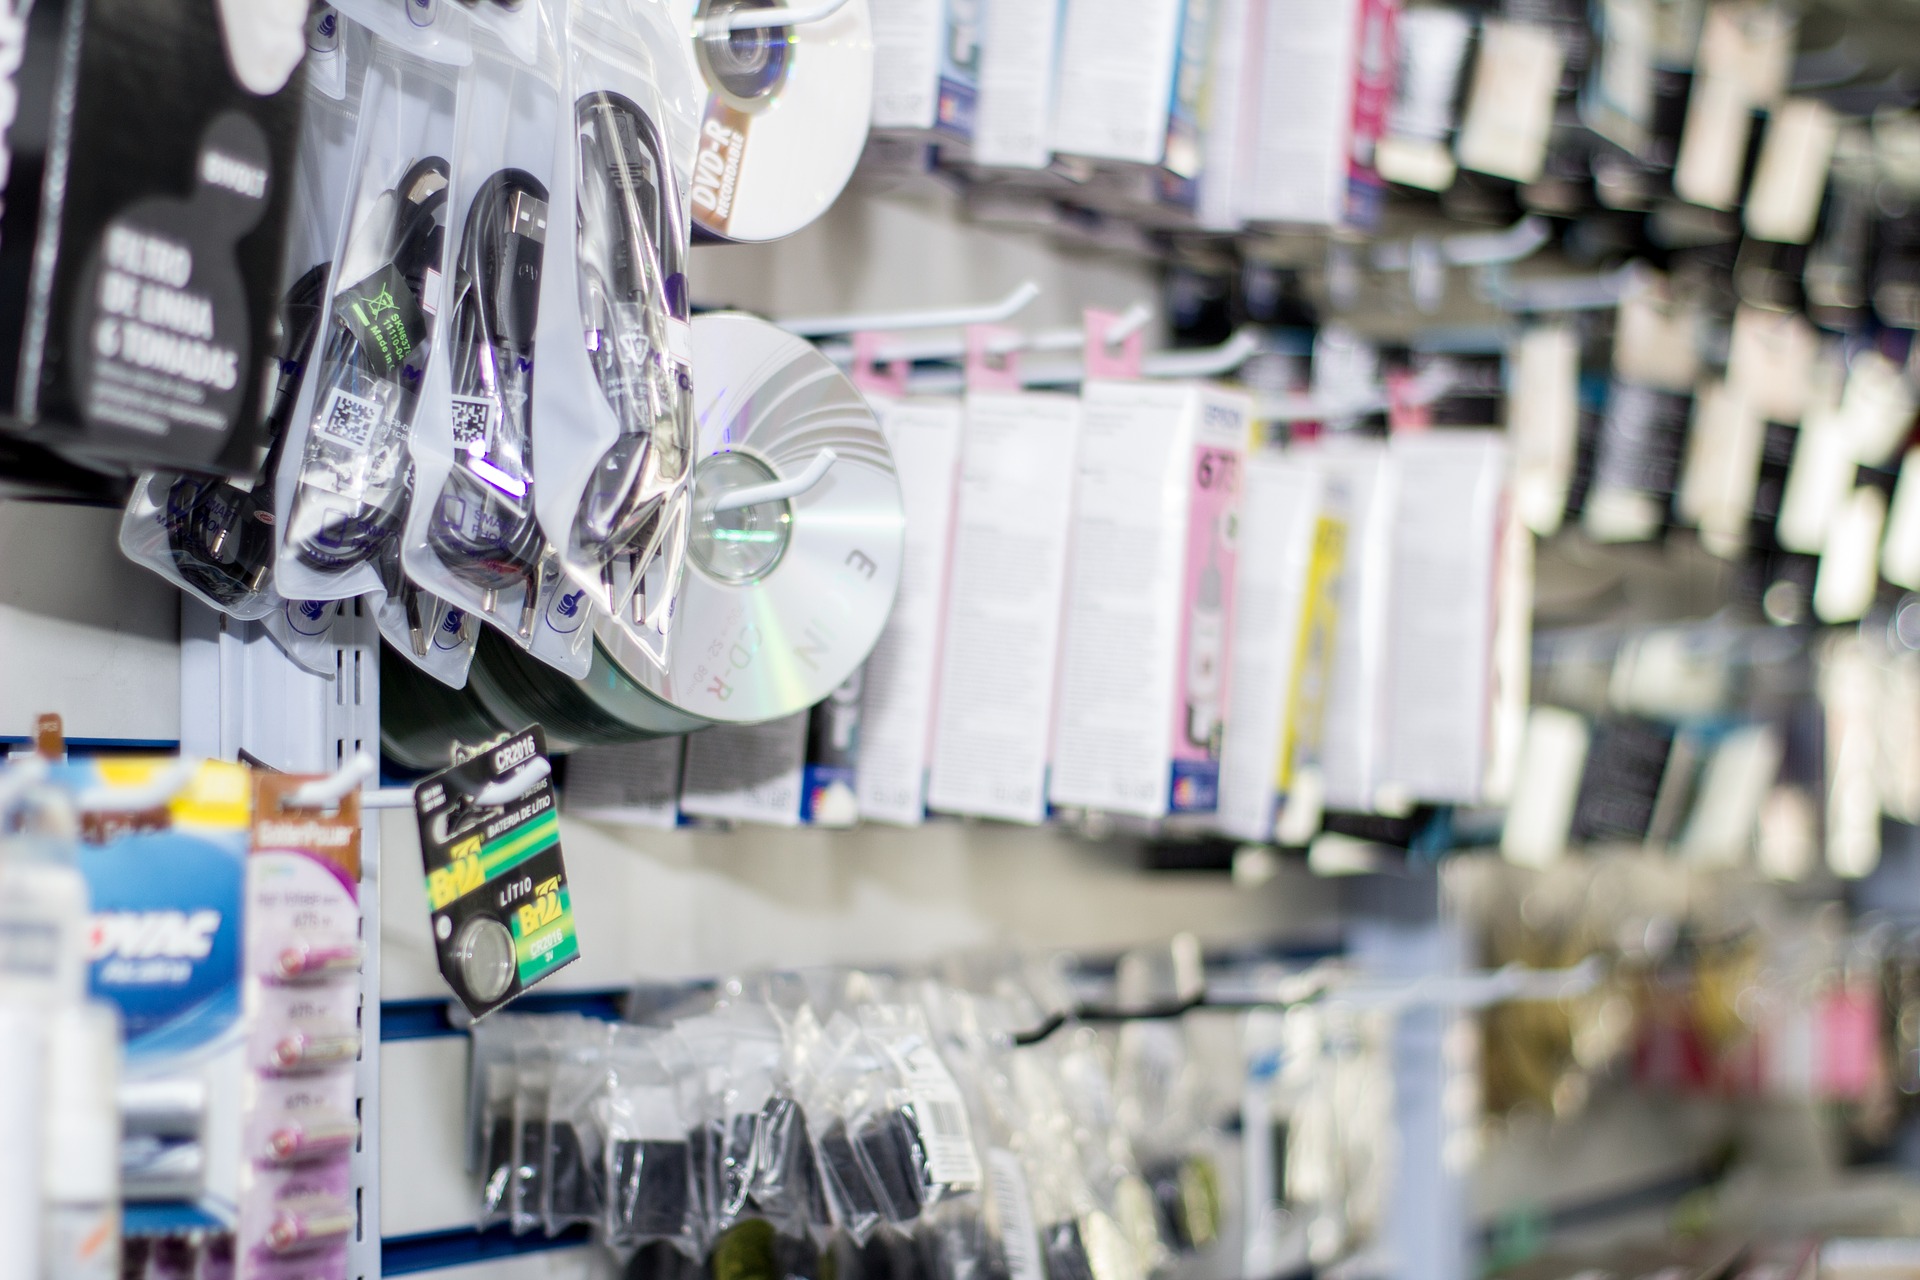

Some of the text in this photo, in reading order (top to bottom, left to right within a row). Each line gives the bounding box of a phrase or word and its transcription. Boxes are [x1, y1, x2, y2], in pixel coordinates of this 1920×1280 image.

[691, 119, 732, 211] DVD-R
[716, 130, 744, 218] RECORDABLE
[370, 325, 389, 353] Made
[384, 353, 393, 364] in
[706, 624, 763, 702] CD-R
[495, 735, 536, 771] CR2016
[487, 795, 551, 838] BATERIA DE LÍTIO
[501, 876, 532, 907] LÍTIO
[530, 928, 564, 958] CR2016
